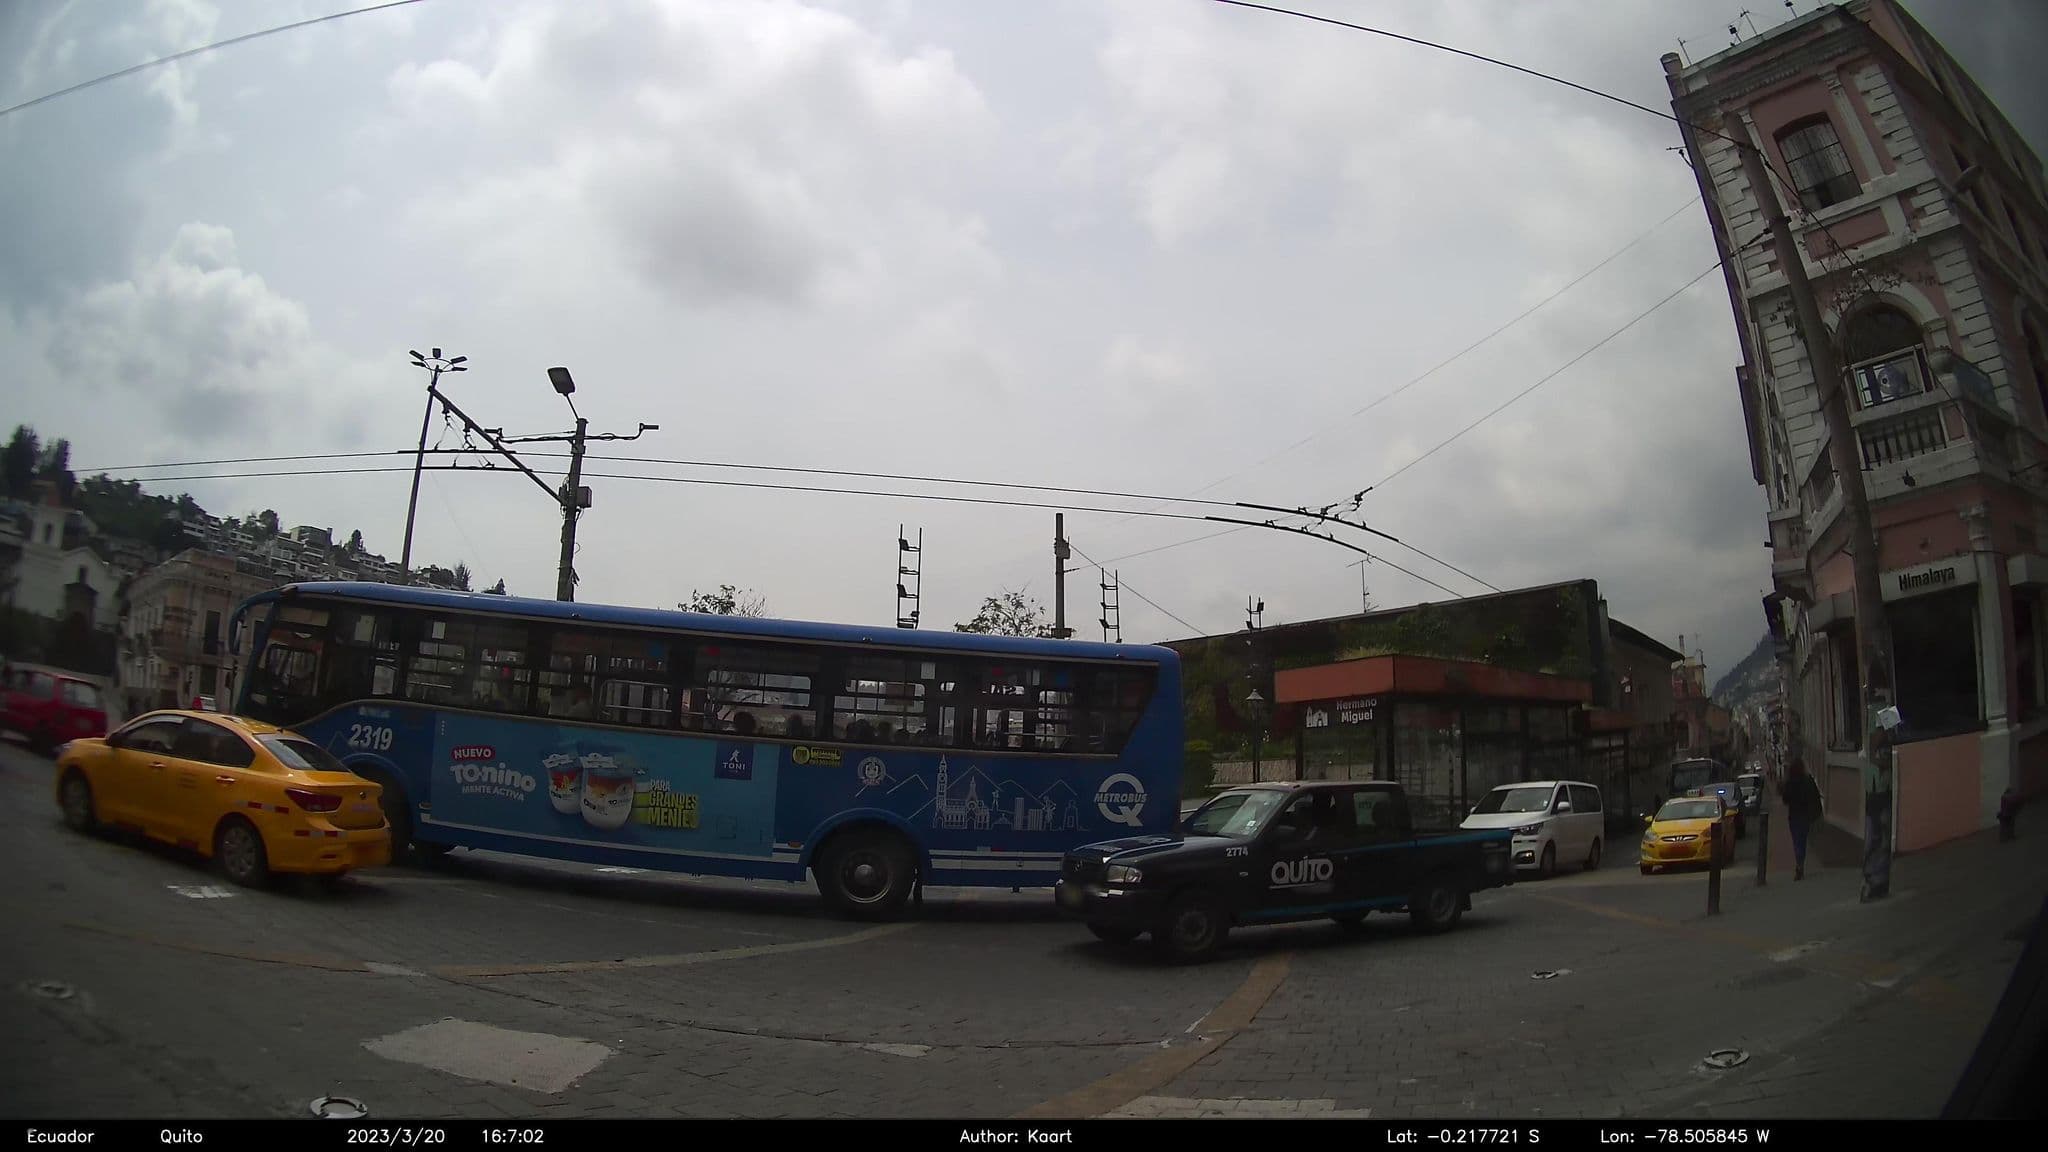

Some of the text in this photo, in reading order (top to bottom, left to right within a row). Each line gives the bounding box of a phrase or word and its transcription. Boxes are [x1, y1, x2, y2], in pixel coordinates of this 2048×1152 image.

[1898, 566, 1956, 591] Himalaya
[1336, 698, 1377, 711] Hermano
[1341, 708, 1373, 724] Miguel
[348, 723, 393, 751] 2319
[454, 748, 492, 760] NUEVO
[722, 762, 746, 771] TONI
[649, 778, 672, 792] PARA
[462, 784, 524, 801] MENTE ACTIVA
[1094, 792, 1148, 803] METROBUS
[649, 792, 697, 810] GRANDES
[1225, 846, 1249, 857] 2774
